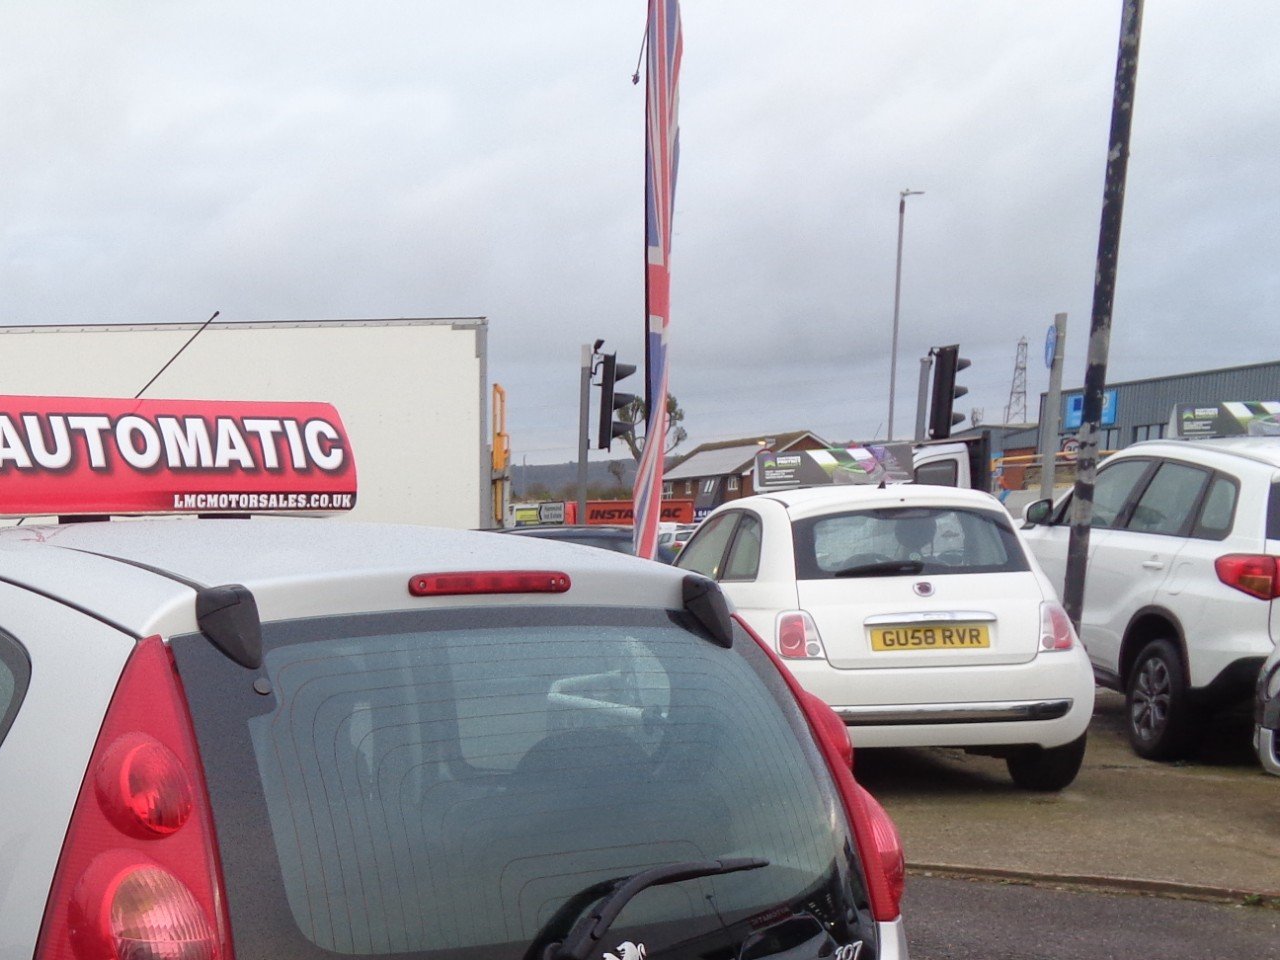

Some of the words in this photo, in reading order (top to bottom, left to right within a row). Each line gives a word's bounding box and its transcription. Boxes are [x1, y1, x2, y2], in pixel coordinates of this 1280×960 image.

[173, 494, 352, 509] LMCMOTORSALES.CO.UK
[882, 629, 936, 646] GU58
[941, 628, 982, 645] RVR
